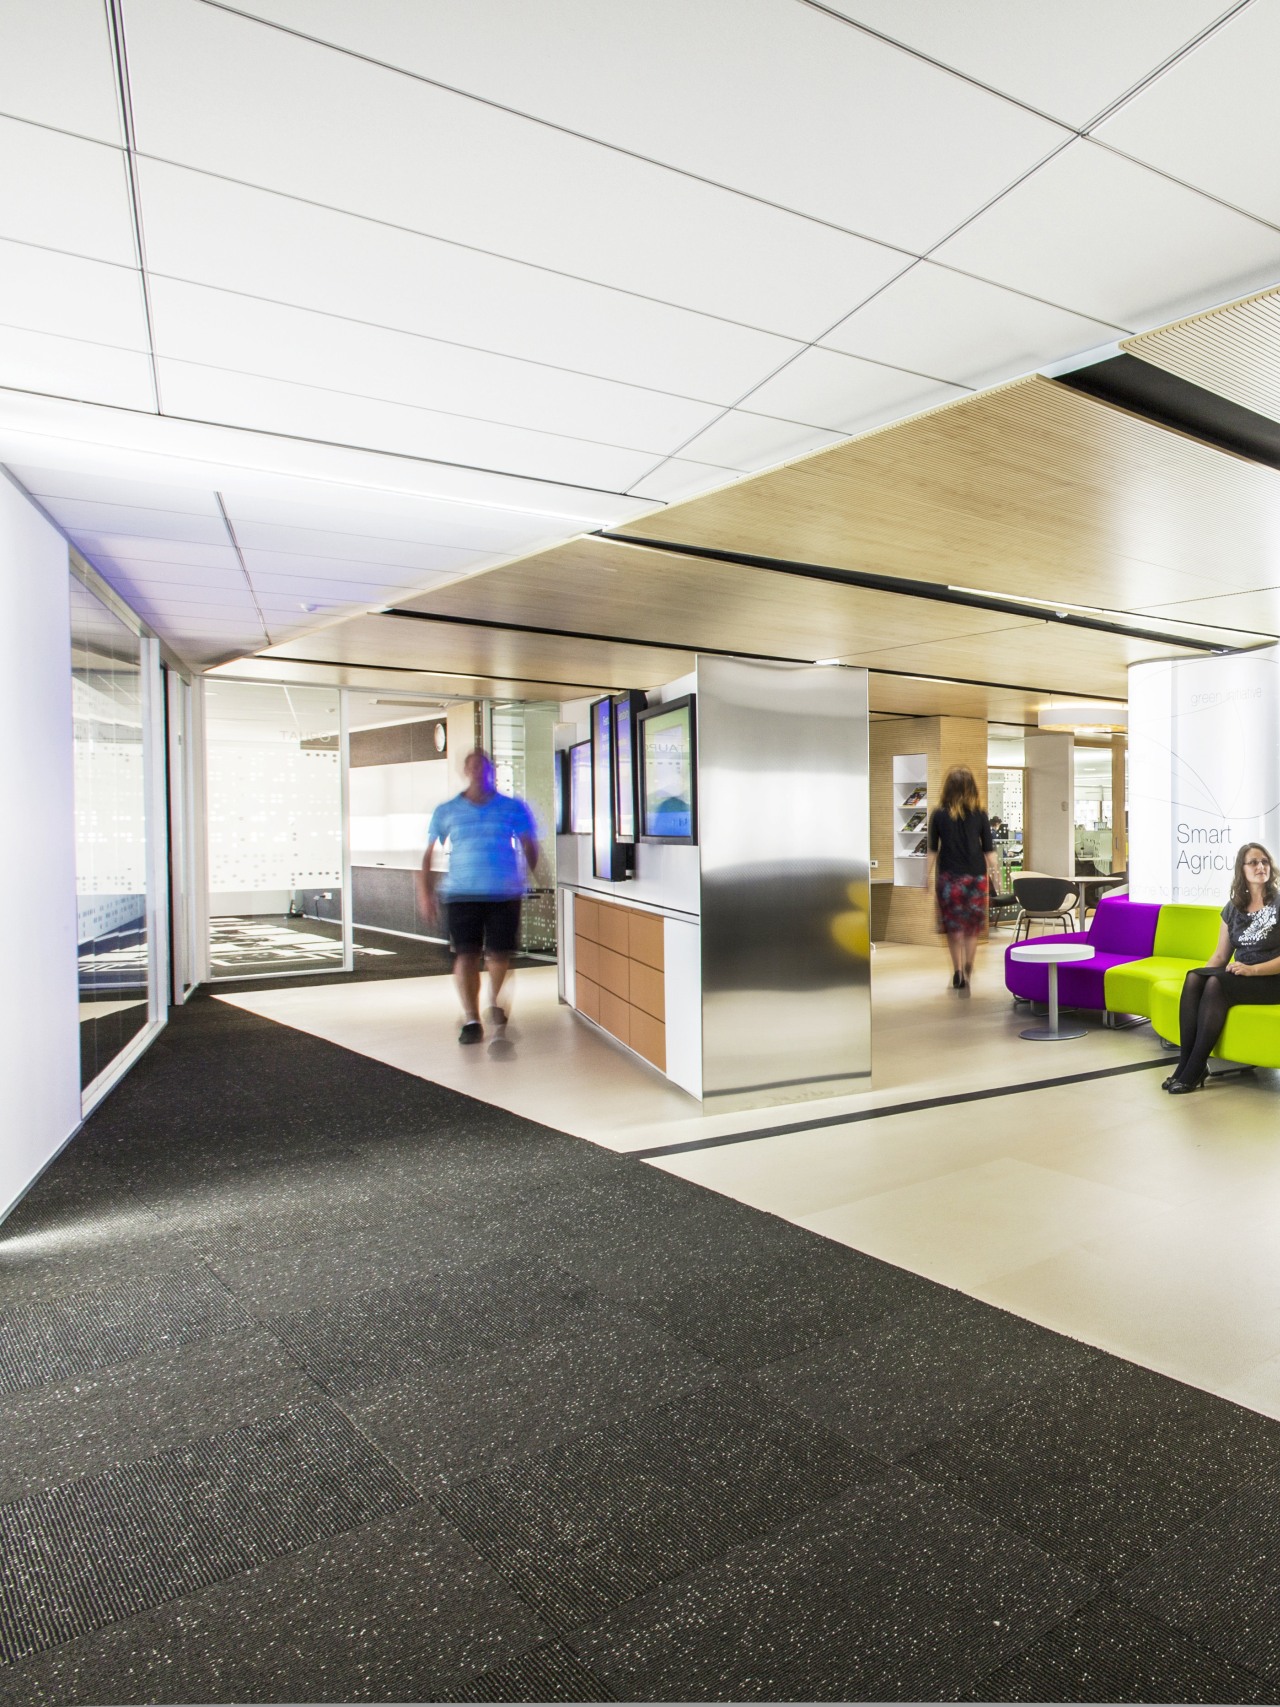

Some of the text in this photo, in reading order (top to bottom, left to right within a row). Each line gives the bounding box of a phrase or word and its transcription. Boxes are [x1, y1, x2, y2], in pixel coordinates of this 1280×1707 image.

[1190, 691, 1222, 707] green
[279, 730, 331, 743] TAUPO
[1176, 823, 1232, 844] Smart
[1176, 850, 1236, 875] Agricu
[1172, 884, 1221, 898] machine
